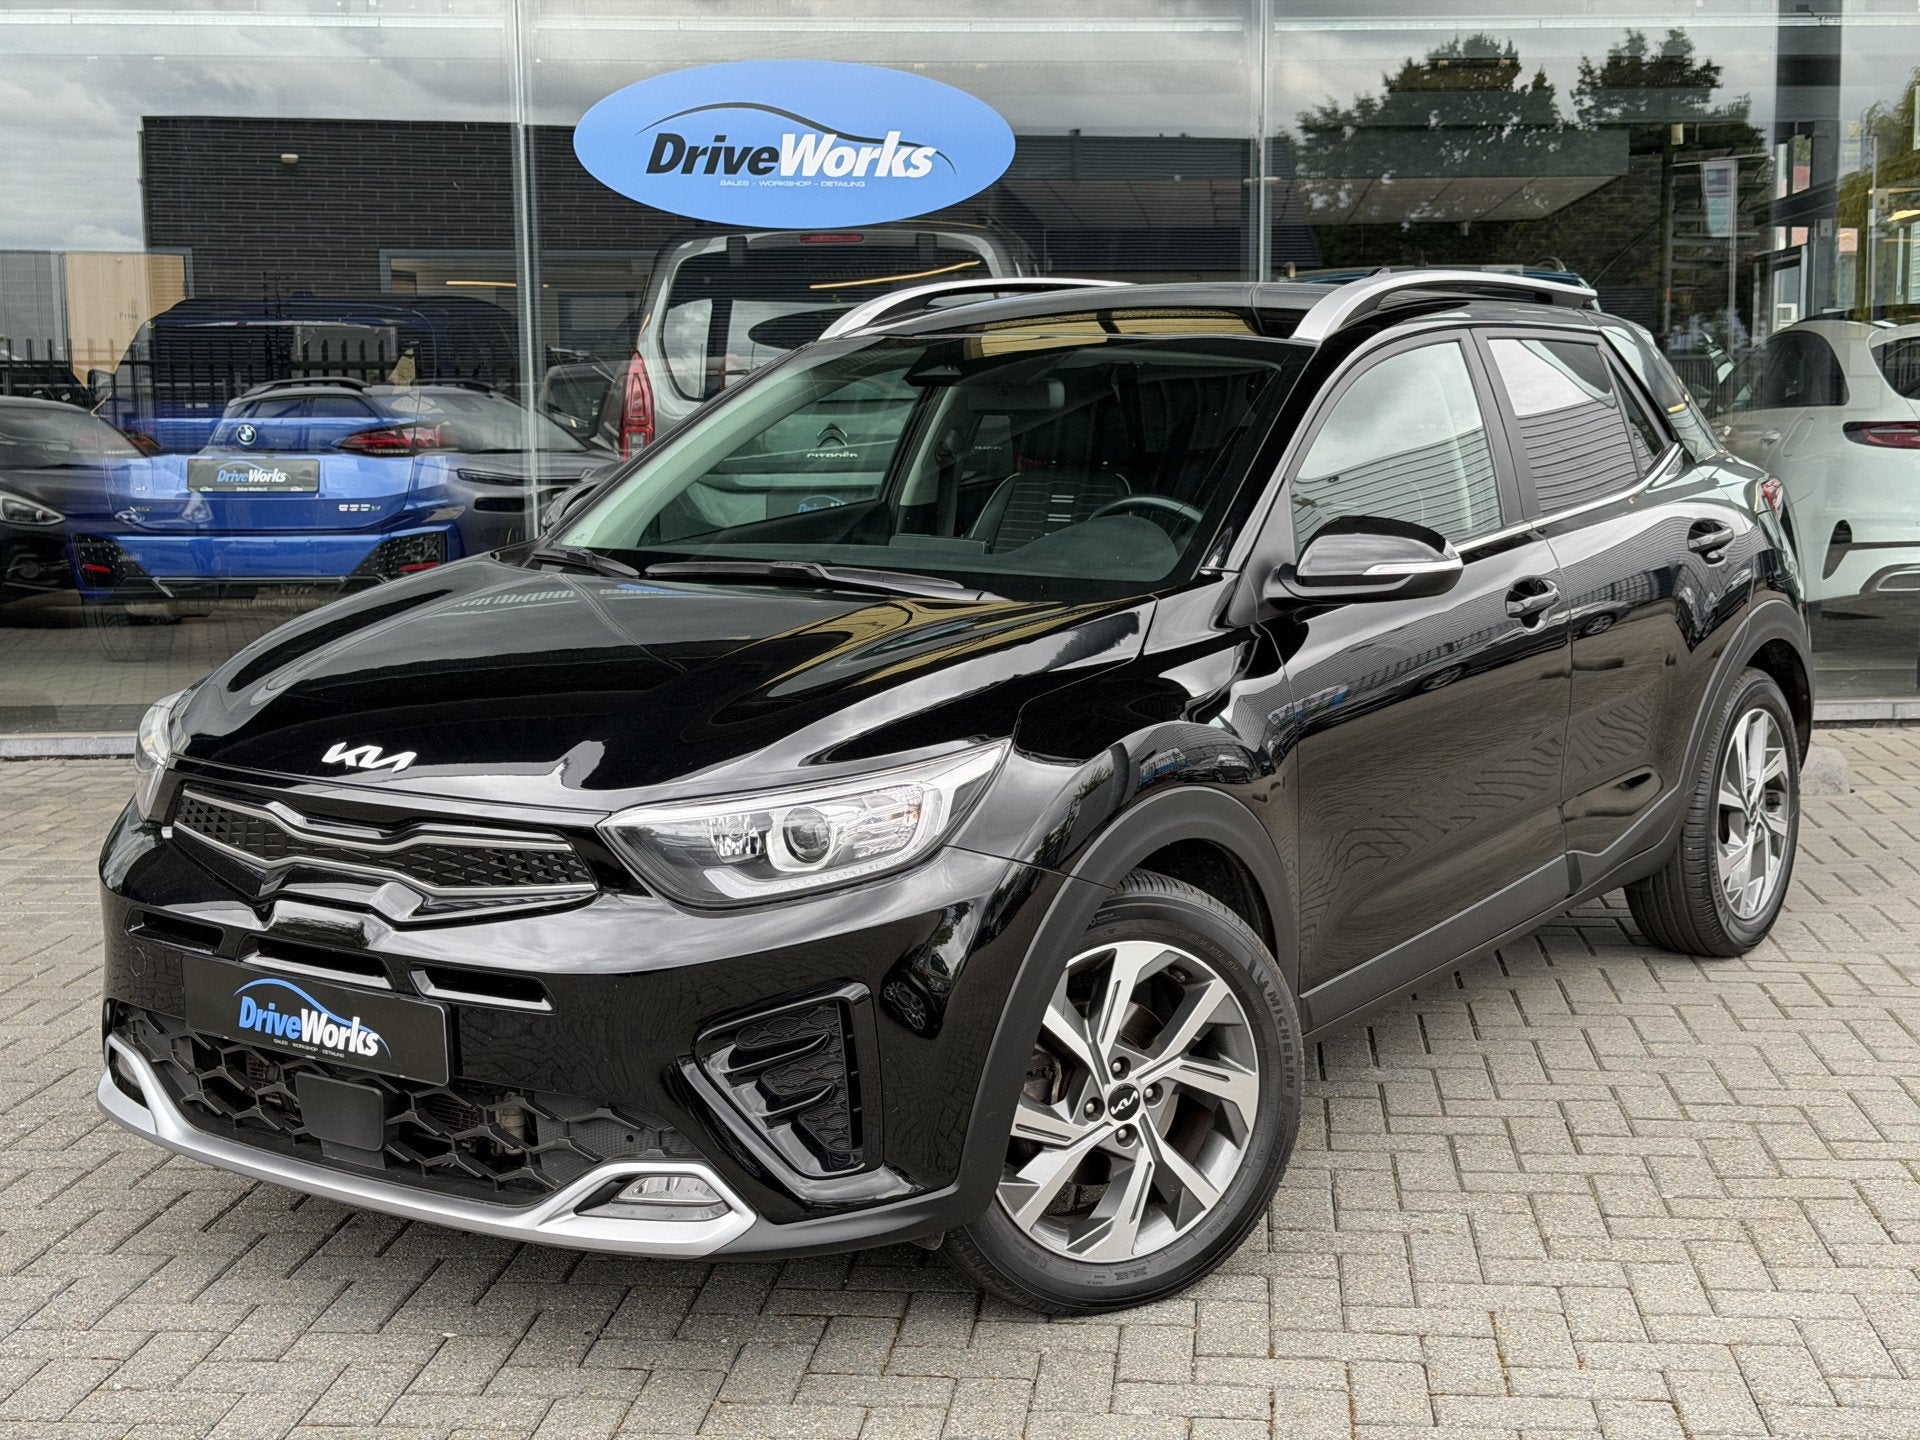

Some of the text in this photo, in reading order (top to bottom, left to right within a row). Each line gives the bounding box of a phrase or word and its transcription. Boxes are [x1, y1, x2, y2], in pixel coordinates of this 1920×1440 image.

[645, 131, 938, 178] DriveWorks
[759, 180, 812, 188] WORKSHOP
[216, 467, 288, 483] DriveWorks
[321, 741, 418, 774] KIA
[238, 996, 380, 1058] DriveWorks
[1265, 990, 1295, 1090] MICHELIN
[273, 1038, 346, 1059] SALES WORKSHOP DETAILING
[1110, 1090, 1139, 1115] KIA
